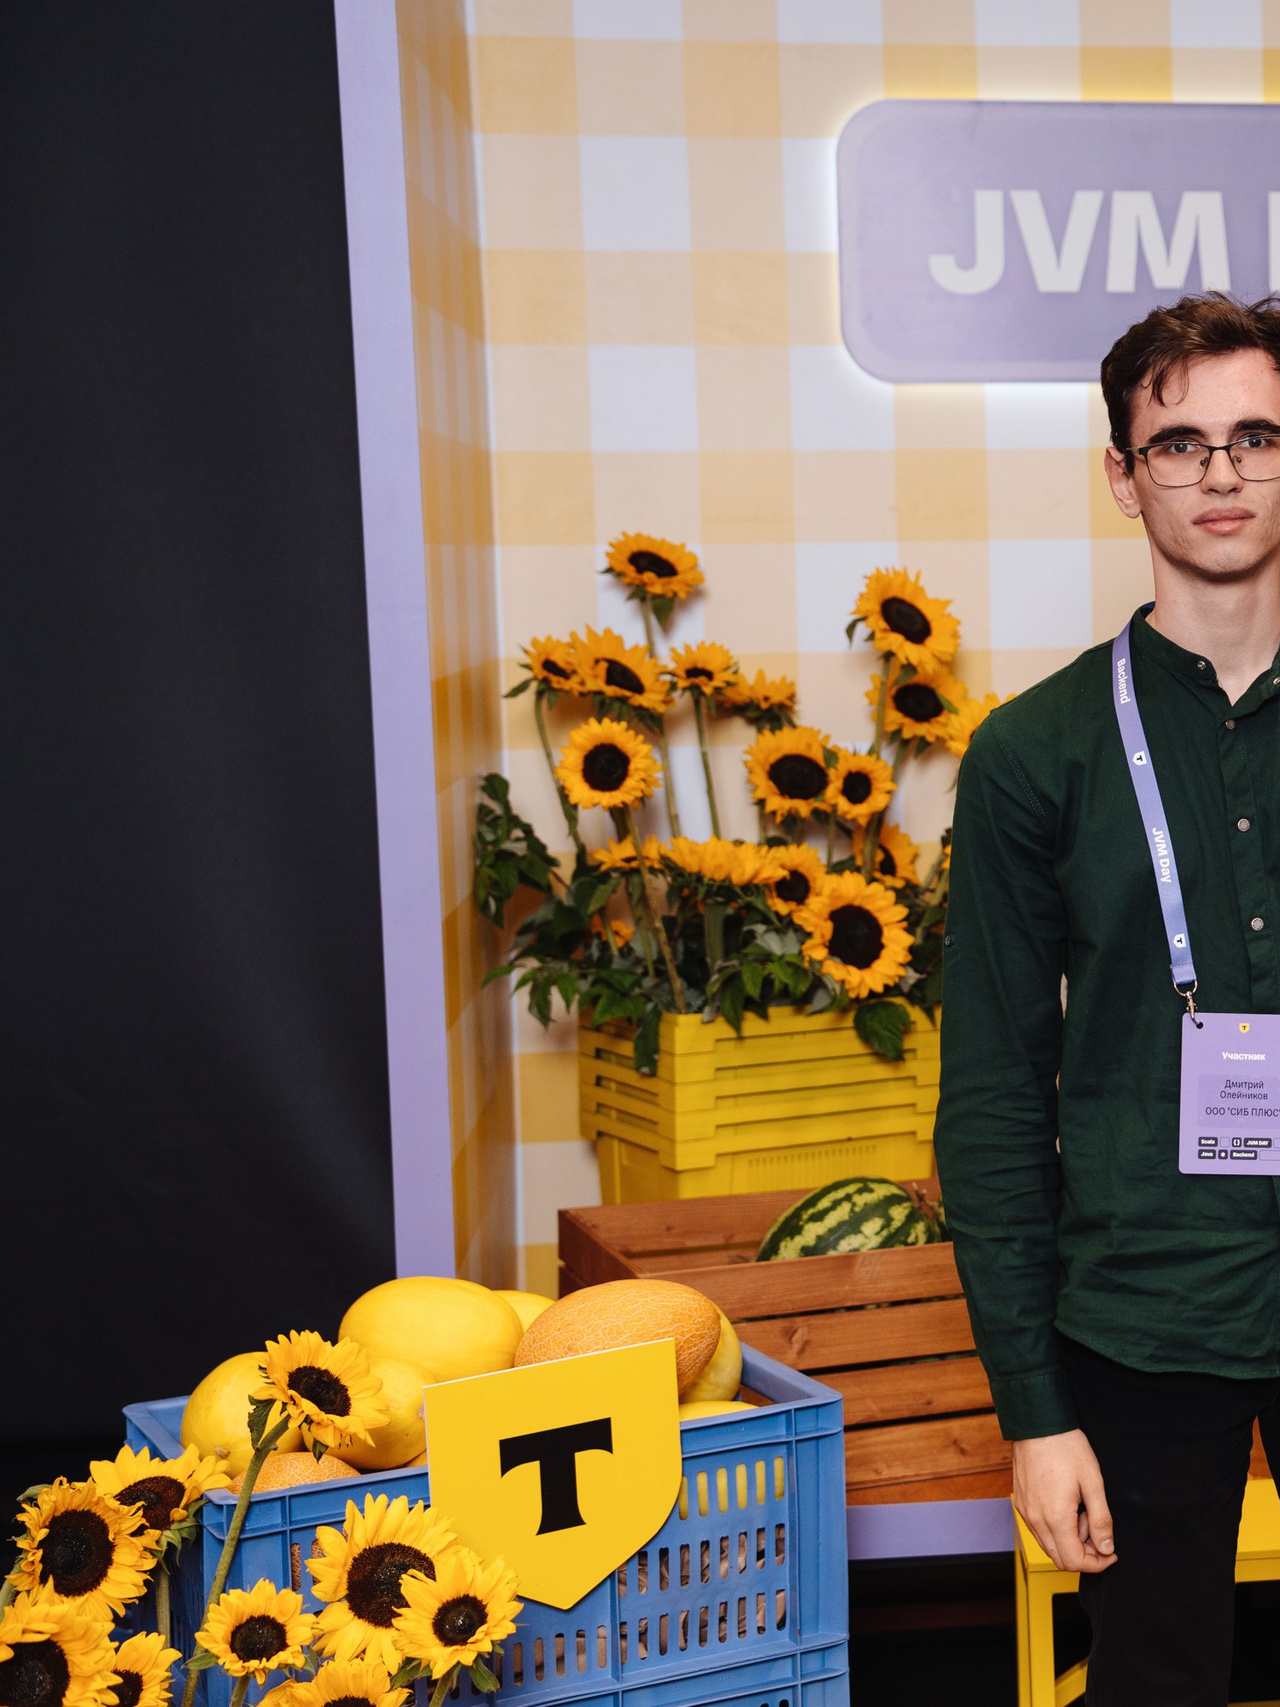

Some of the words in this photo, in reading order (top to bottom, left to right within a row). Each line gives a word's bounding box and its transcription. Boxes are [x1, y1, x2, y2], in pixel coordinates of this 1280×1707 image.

[928, 189, 1231, 295] JVM
[1117, 658, 1130, 704] Backend
[1152, 827, 1168, 856] JVM
[1159, 858, 1172, 883] Day
[1222, 1052, 1266, 1061] Участник
[1220, 1090, 1268, 1100] Олейников
[1224, 1079, 1264, 1089] Дмитрий
[1205, 1106, 1226, 1116] ООО
[499, 1417, 614, 1536] T
